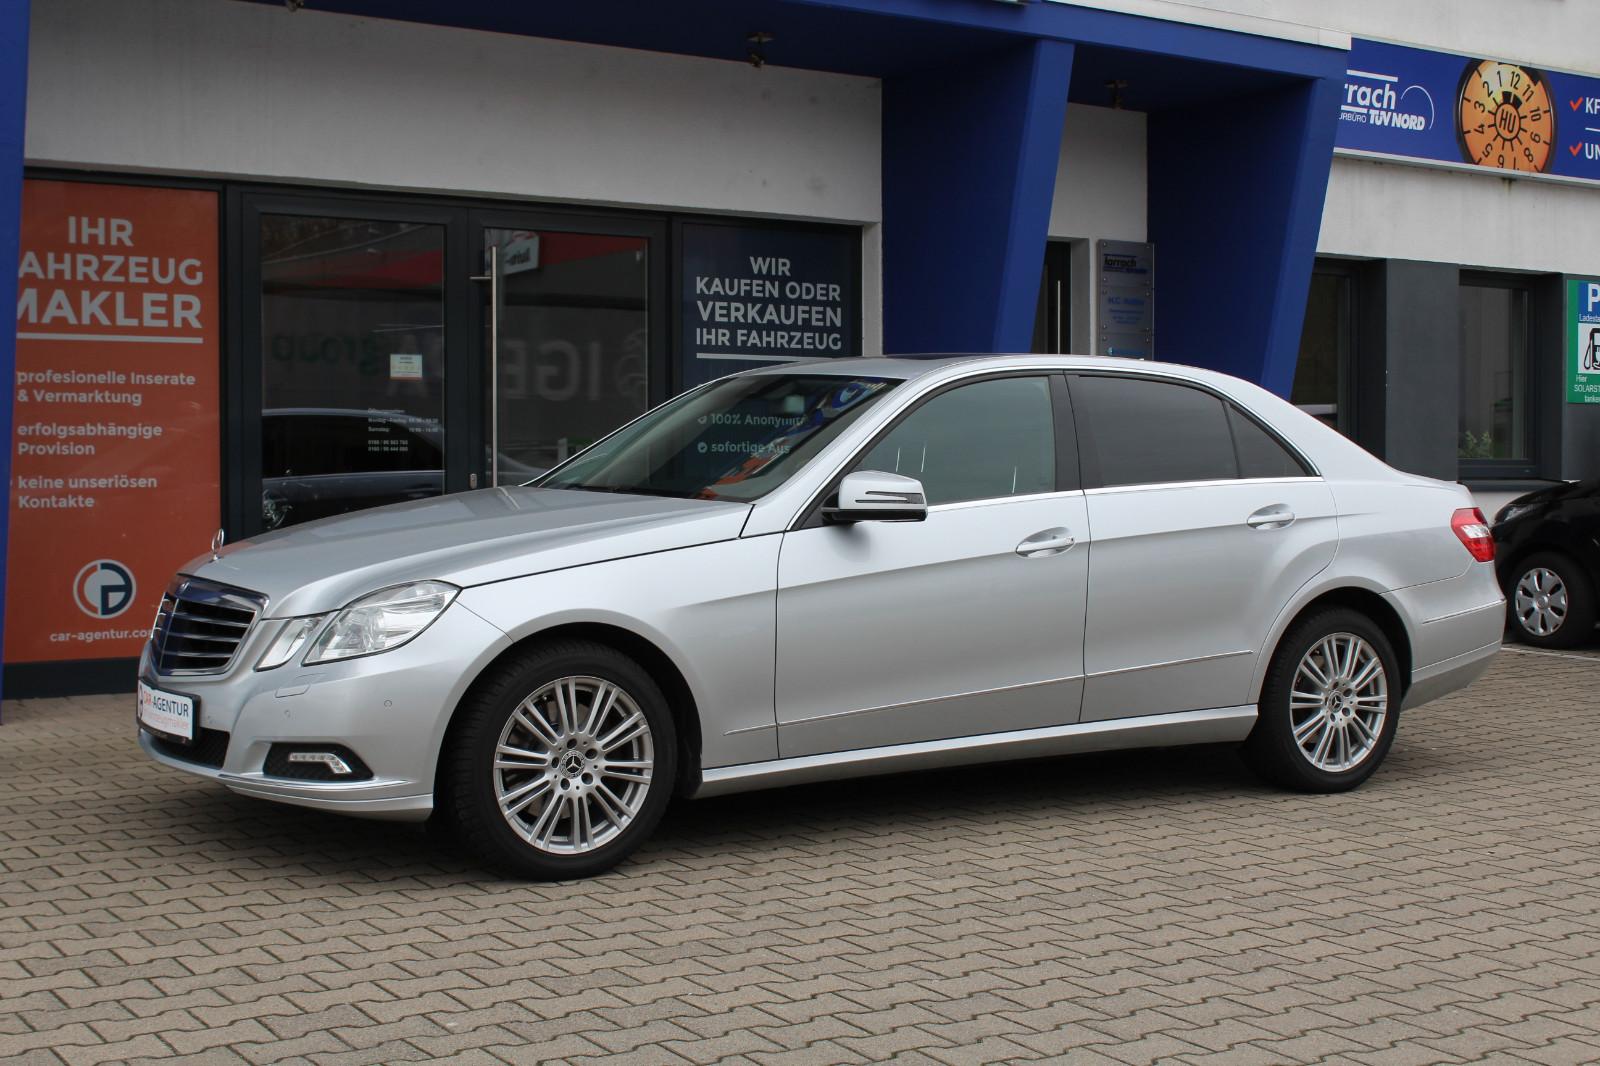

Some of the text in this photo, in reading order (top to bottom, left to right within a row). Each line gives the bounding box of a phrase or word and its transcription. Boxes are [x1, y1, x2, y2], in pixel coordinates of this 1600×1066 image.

[1497, 70, 1502, 87] 1
[1510, 71, 1521, 90] 12
[1344, 83, 1397, 110] rach
[1482, 81, 1493, 98] 2
[1522, 84, 1534, 102] 11
[1474, 100, 1486, 113] 3
[1530, 106, 1541, 122] 10
[1369, 109, 1392, 126] TÜV
[1391, 112, 1426, 131] NORD
[1499, 109, 1517, 133] HU
[1474, 124, 1485, 134] 4
[1482, 143, 1493, 158] 5
[1523, 147, 1534, 163] 8
[68, 216, 134, 246] IHR
[750, 256, 791, 277] WIR
[696, 276, 841, 301] KAUFEN ODER
[1587, 283, 1600, 312] P
[696, 300, 842, 327] VERKAUFEN
[696, 328, 842, 350] IHR FAHRZEUG
[16, 370, 196, 385] profesionelle Inserate
[17, 390, 142, 406] & Vermarktung
[710, 413, 742, 425] 100%
[17, 423, 163, 439] erfolgsabhängige
[18, 442, 95, 455] Provision
[18, 475, 157, 489] keine unseriösen
[19, 495, 95, 509] Kontakte
